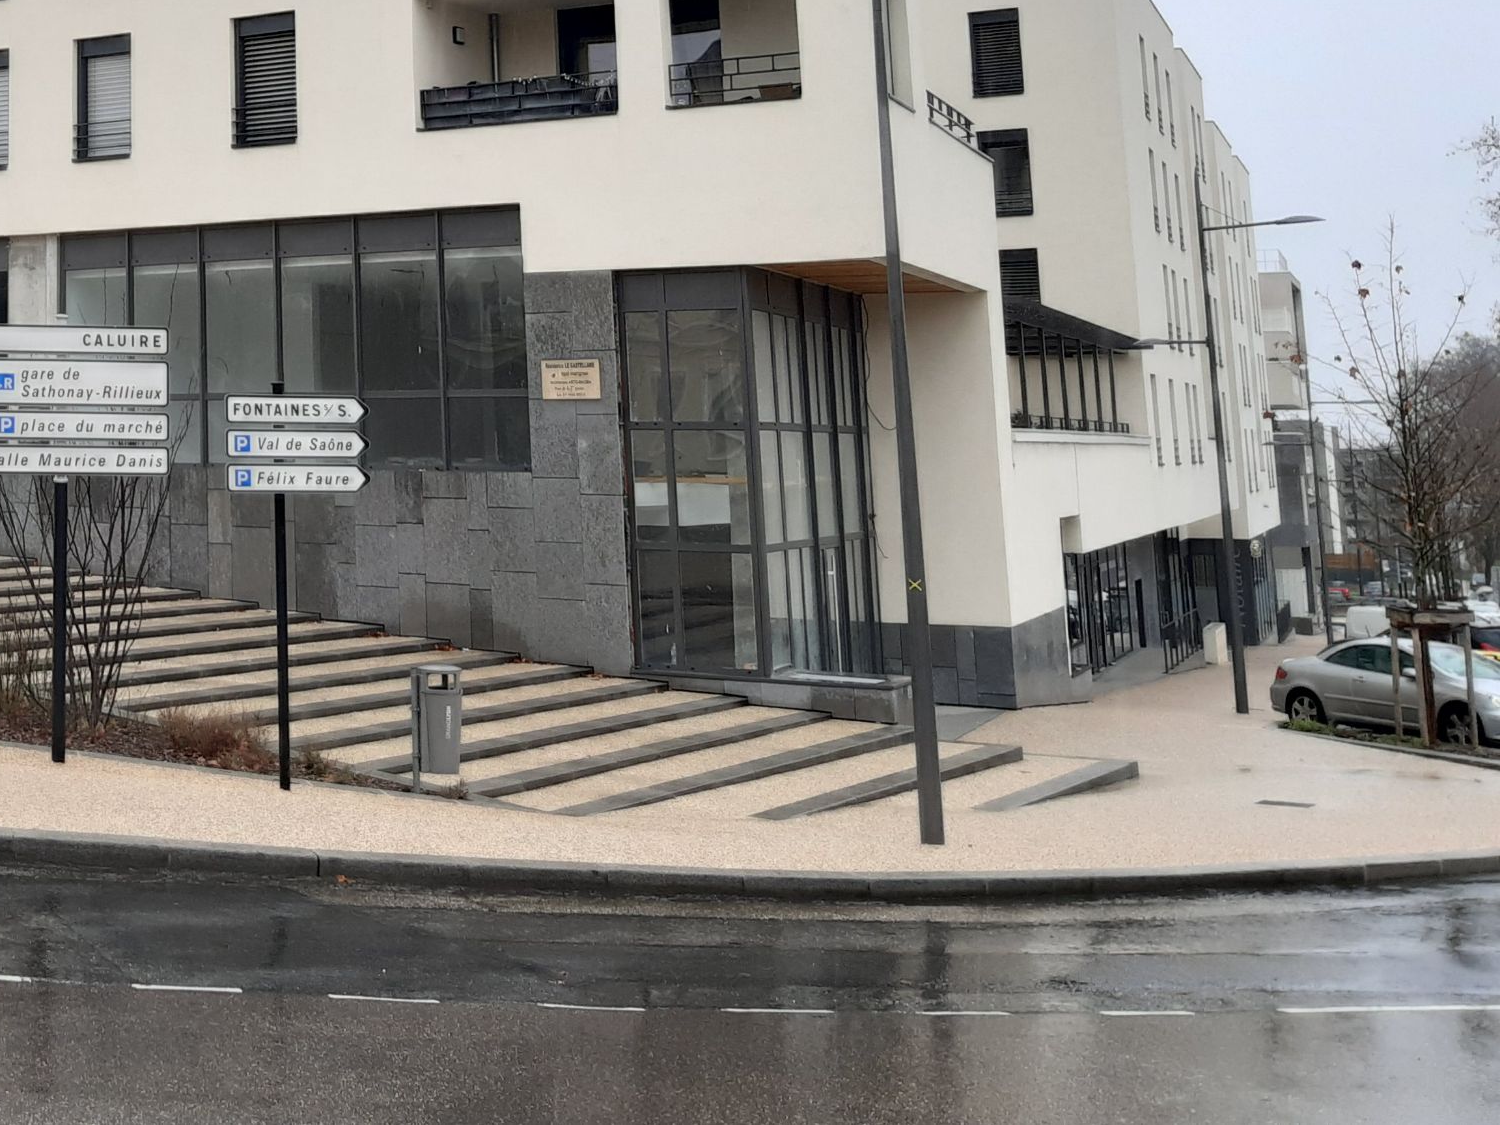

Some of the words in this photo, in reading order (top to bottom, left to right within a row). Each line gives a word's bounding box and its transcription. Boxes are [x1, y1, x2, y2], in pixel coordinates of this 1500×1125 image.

[82, 333, 162, 348] CALUIRE
[20, 369, 54, 383] gare
[63, 368, 80, 380] de
[21, 384, 162, 401] Sathonay-Rillieux
[233, 403, 321, 417] FONTAINES
[0, 418, 13, 432] P
[20, 418, 65, 435] place
[75, 419, 94, 433] du
[103, 420, 163, 434] marché
[236, 437, 249, 451] P
[257, 437, 280, 450] Val
[286, 438, 302, 451] de
[309, 437, 353, 451] Saône
[38, 453, 107, 468] Maurice
[116, 454, 163, 468] Danis
[236, 471, 250, 485] P
[257, 471, 296, 485] Félix
[305, 472, 349, 486] Faure
